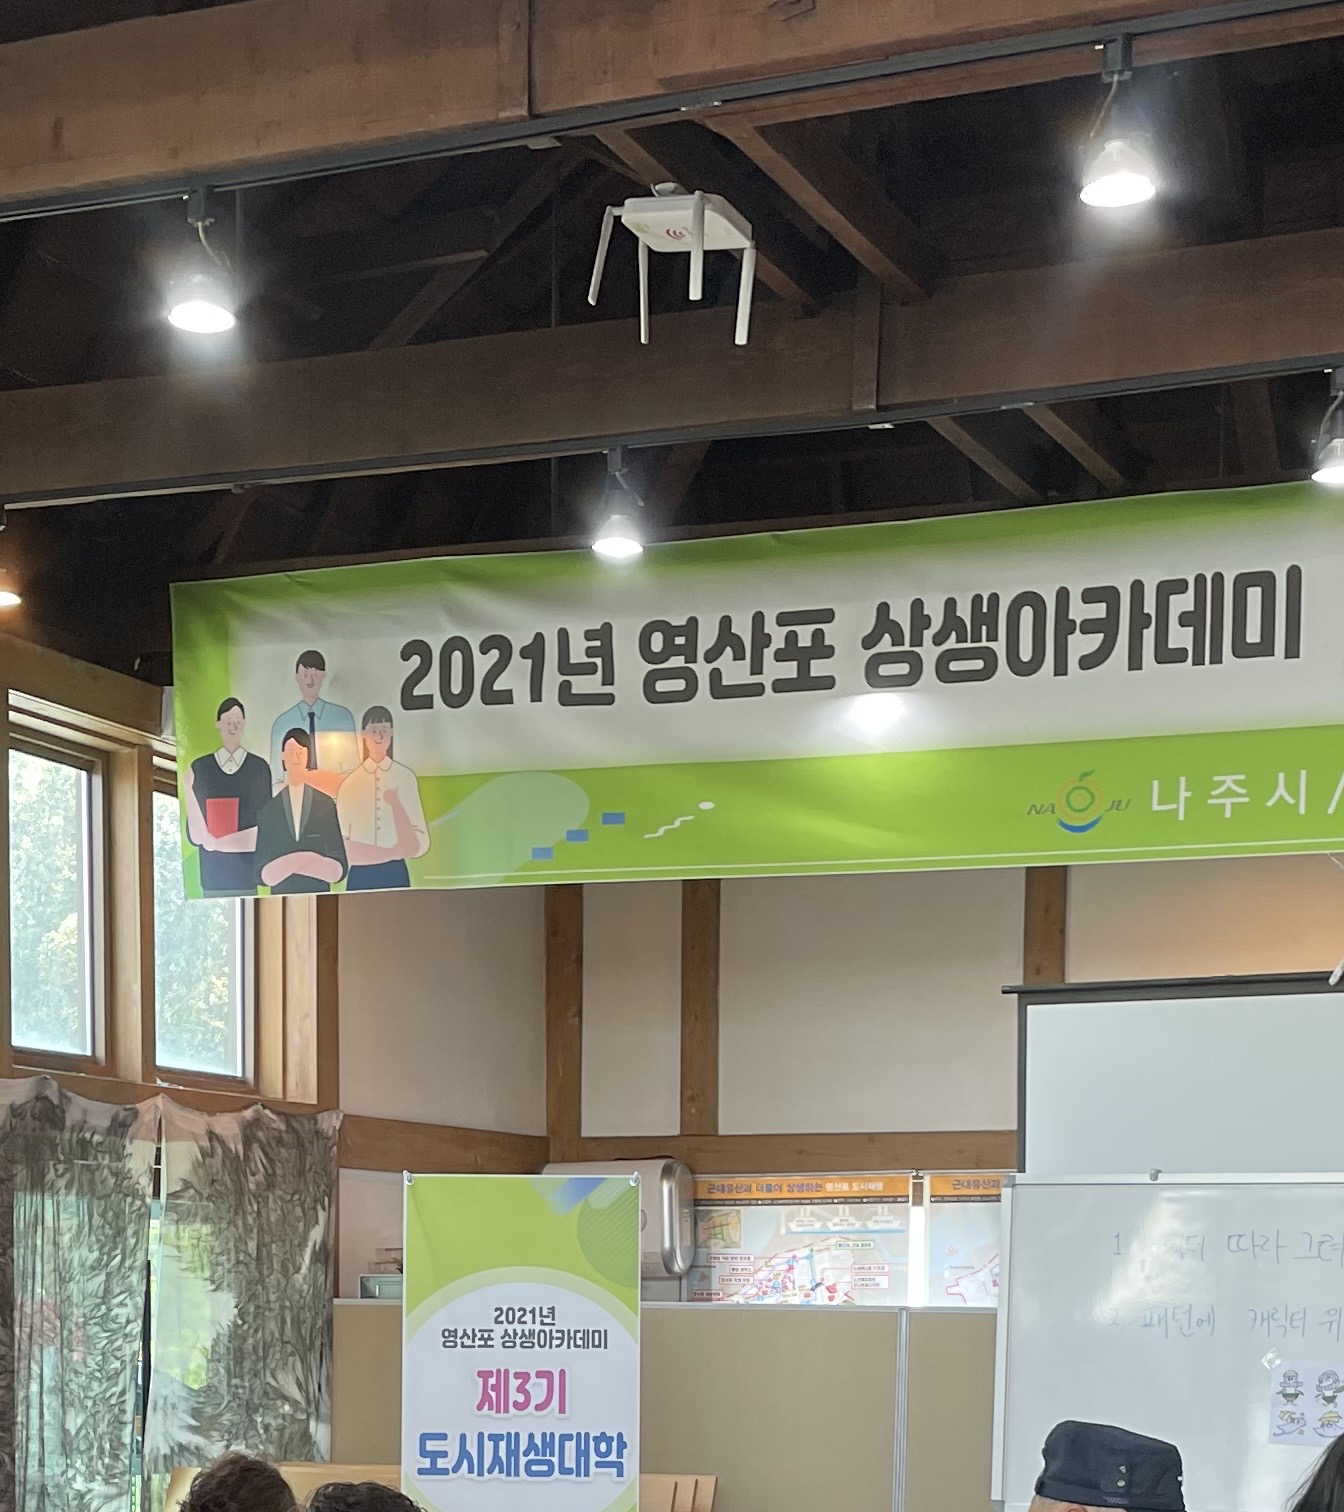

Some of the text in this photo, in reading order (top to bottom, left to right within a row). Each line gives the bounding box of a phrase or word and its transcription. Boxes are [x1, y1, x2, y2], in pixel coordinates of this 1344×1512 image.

[398, 621, 616, 711] 2021년
[638, 606, 837, 705] 영산포
[861, 563, 1303, 689] 상생아카데미
[1226, 1229, 1289, 1265] 따라
[493, 1305, 557, 1327] 2021년
[1246, 1304, 1307, 1339] 캐릭터
[441, 1327, 609, 1350] 영산포 상생아카데미
[476, 1368, 568, 1415] 제3기
[416, 1430, 629, 1479] 도시재생대학
